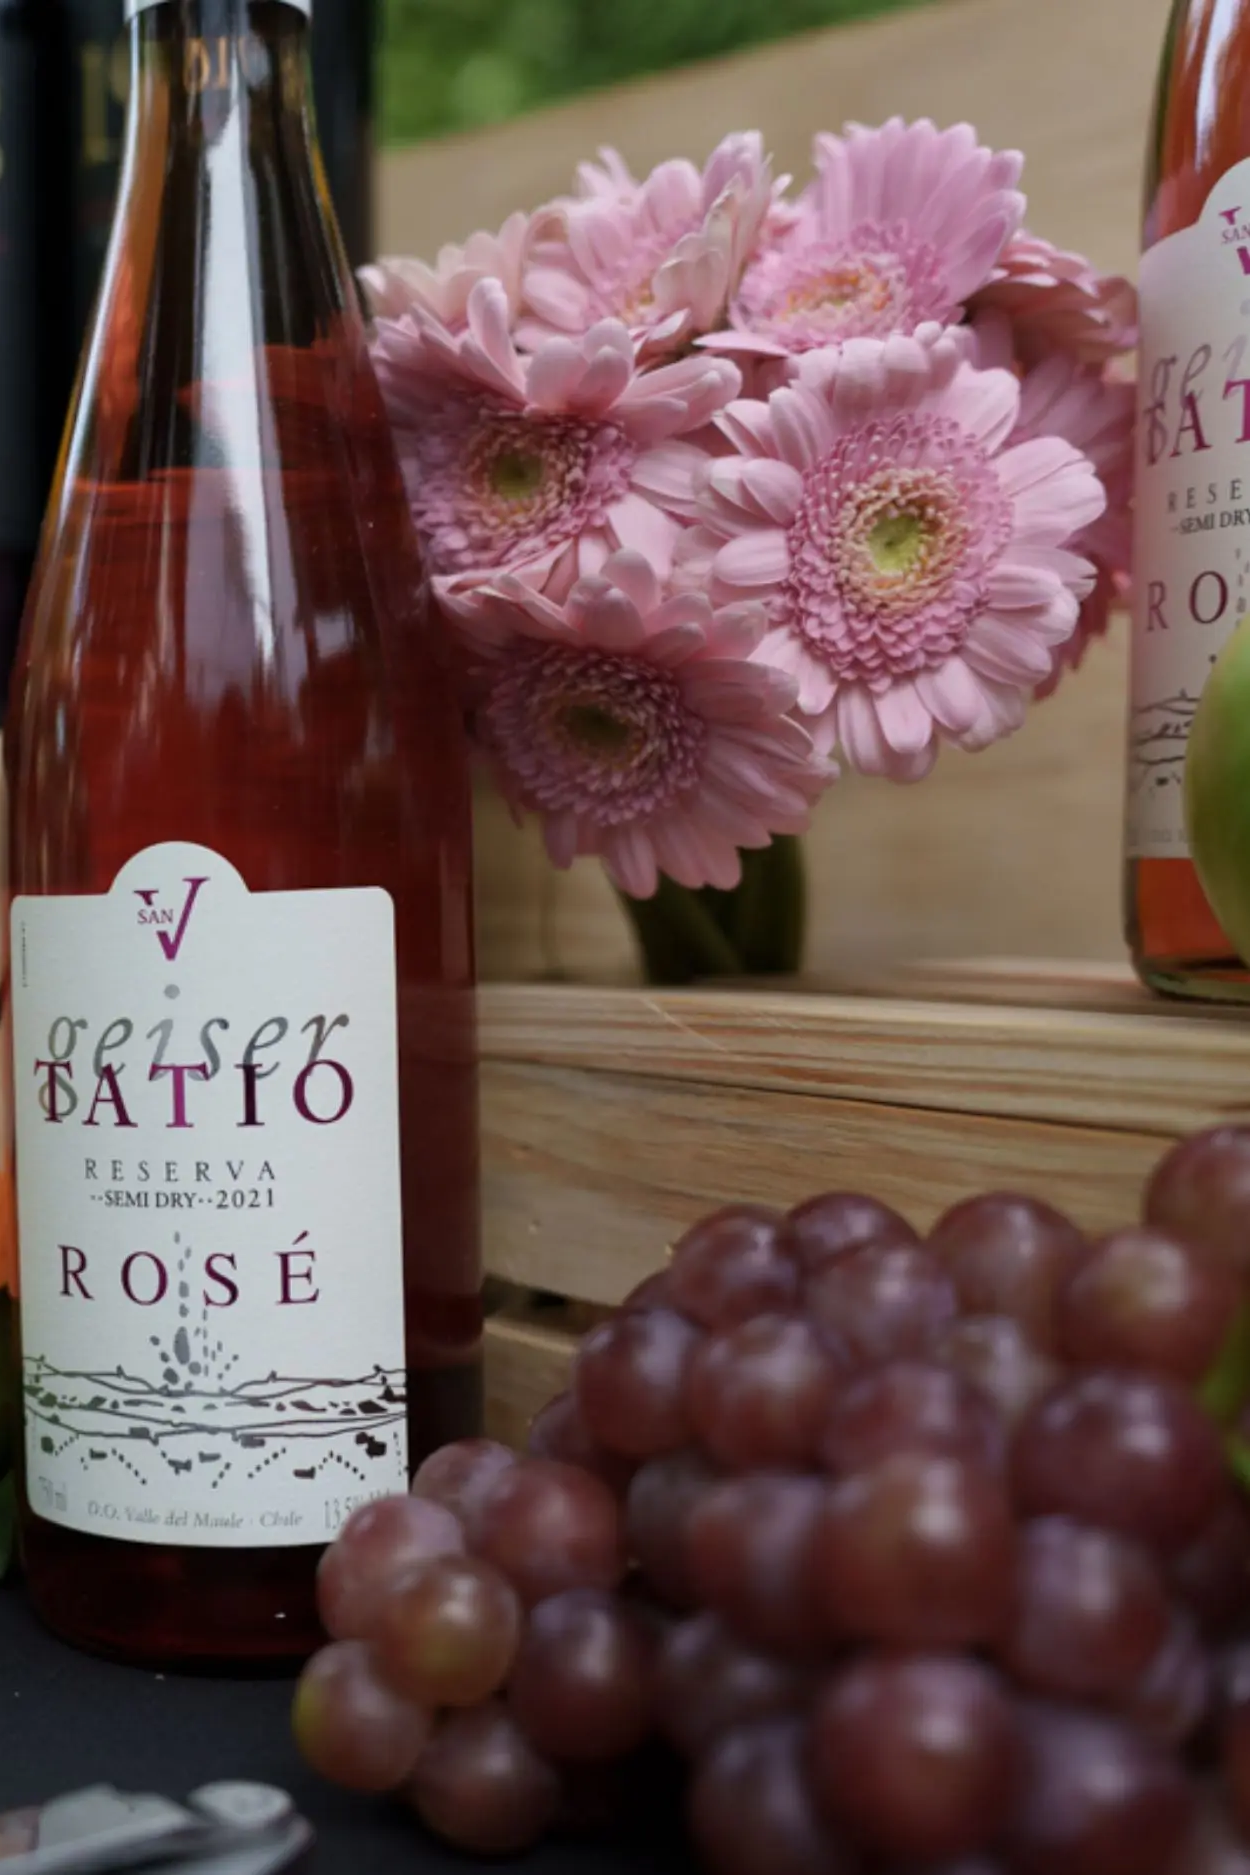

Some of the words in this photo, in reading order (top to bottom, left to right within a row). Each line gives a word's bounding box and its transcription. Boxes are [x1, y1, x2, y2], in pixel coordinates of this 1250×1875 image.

[137, 908, 174, 925] SAN
[34, 1058, 354, 1128] TATIO
[84, 1157, 276, 1182] RESERVA
[104, 1189, 150, 1208] SEMI
[155, 1191, 197, 1209] DRY
[216, 1187, 276, 1210] 2021
[58, 1230, 320, 1307] ROSÉ
